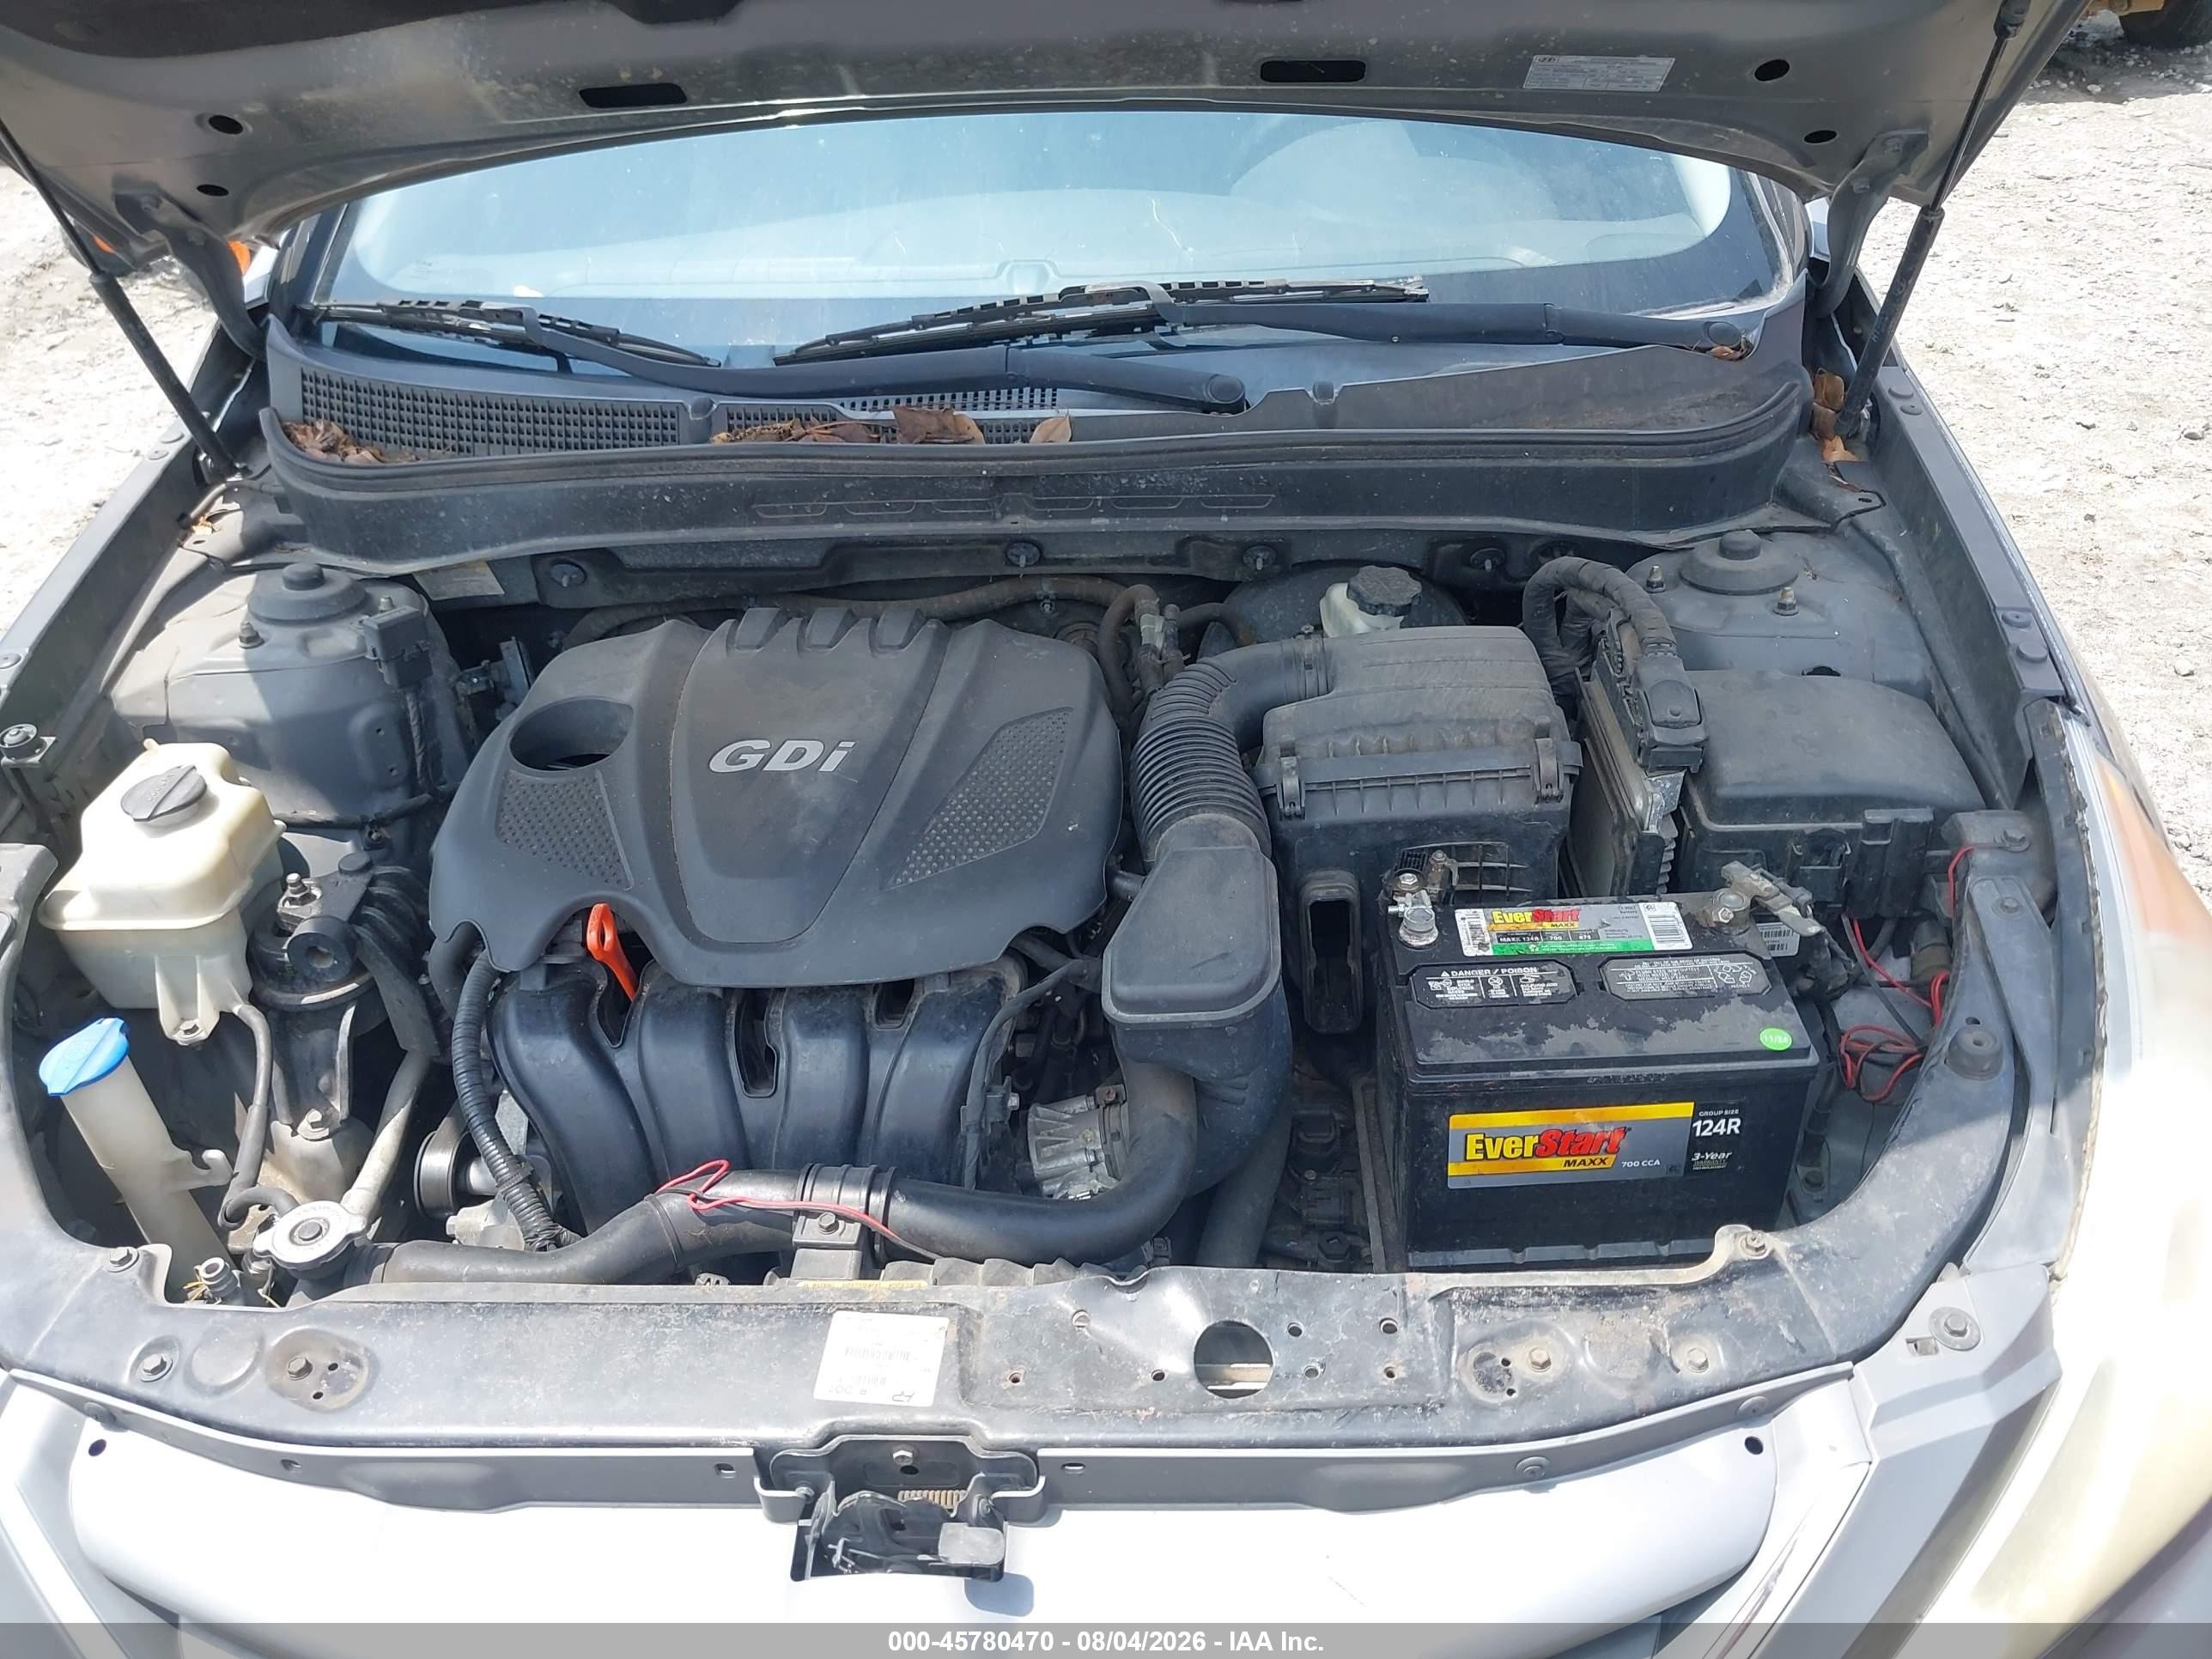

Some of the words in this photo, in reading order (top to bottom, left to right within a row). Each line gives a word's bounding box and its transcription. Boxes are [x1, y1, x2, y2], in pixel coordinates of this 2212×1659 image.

[708, 740, 856, 773] GDi
[1492, 908, 1580, 924] EverStart
[1692, 1118, 1741, 1137] 124R
[1465, 1126, 1627, 1161] EverStart
[1562, 1157, 1608, 1168] MAXX
[1641, 1158, 1661, 1167] CCA
[1691, 1152, 1733, 1162] 3-Year
